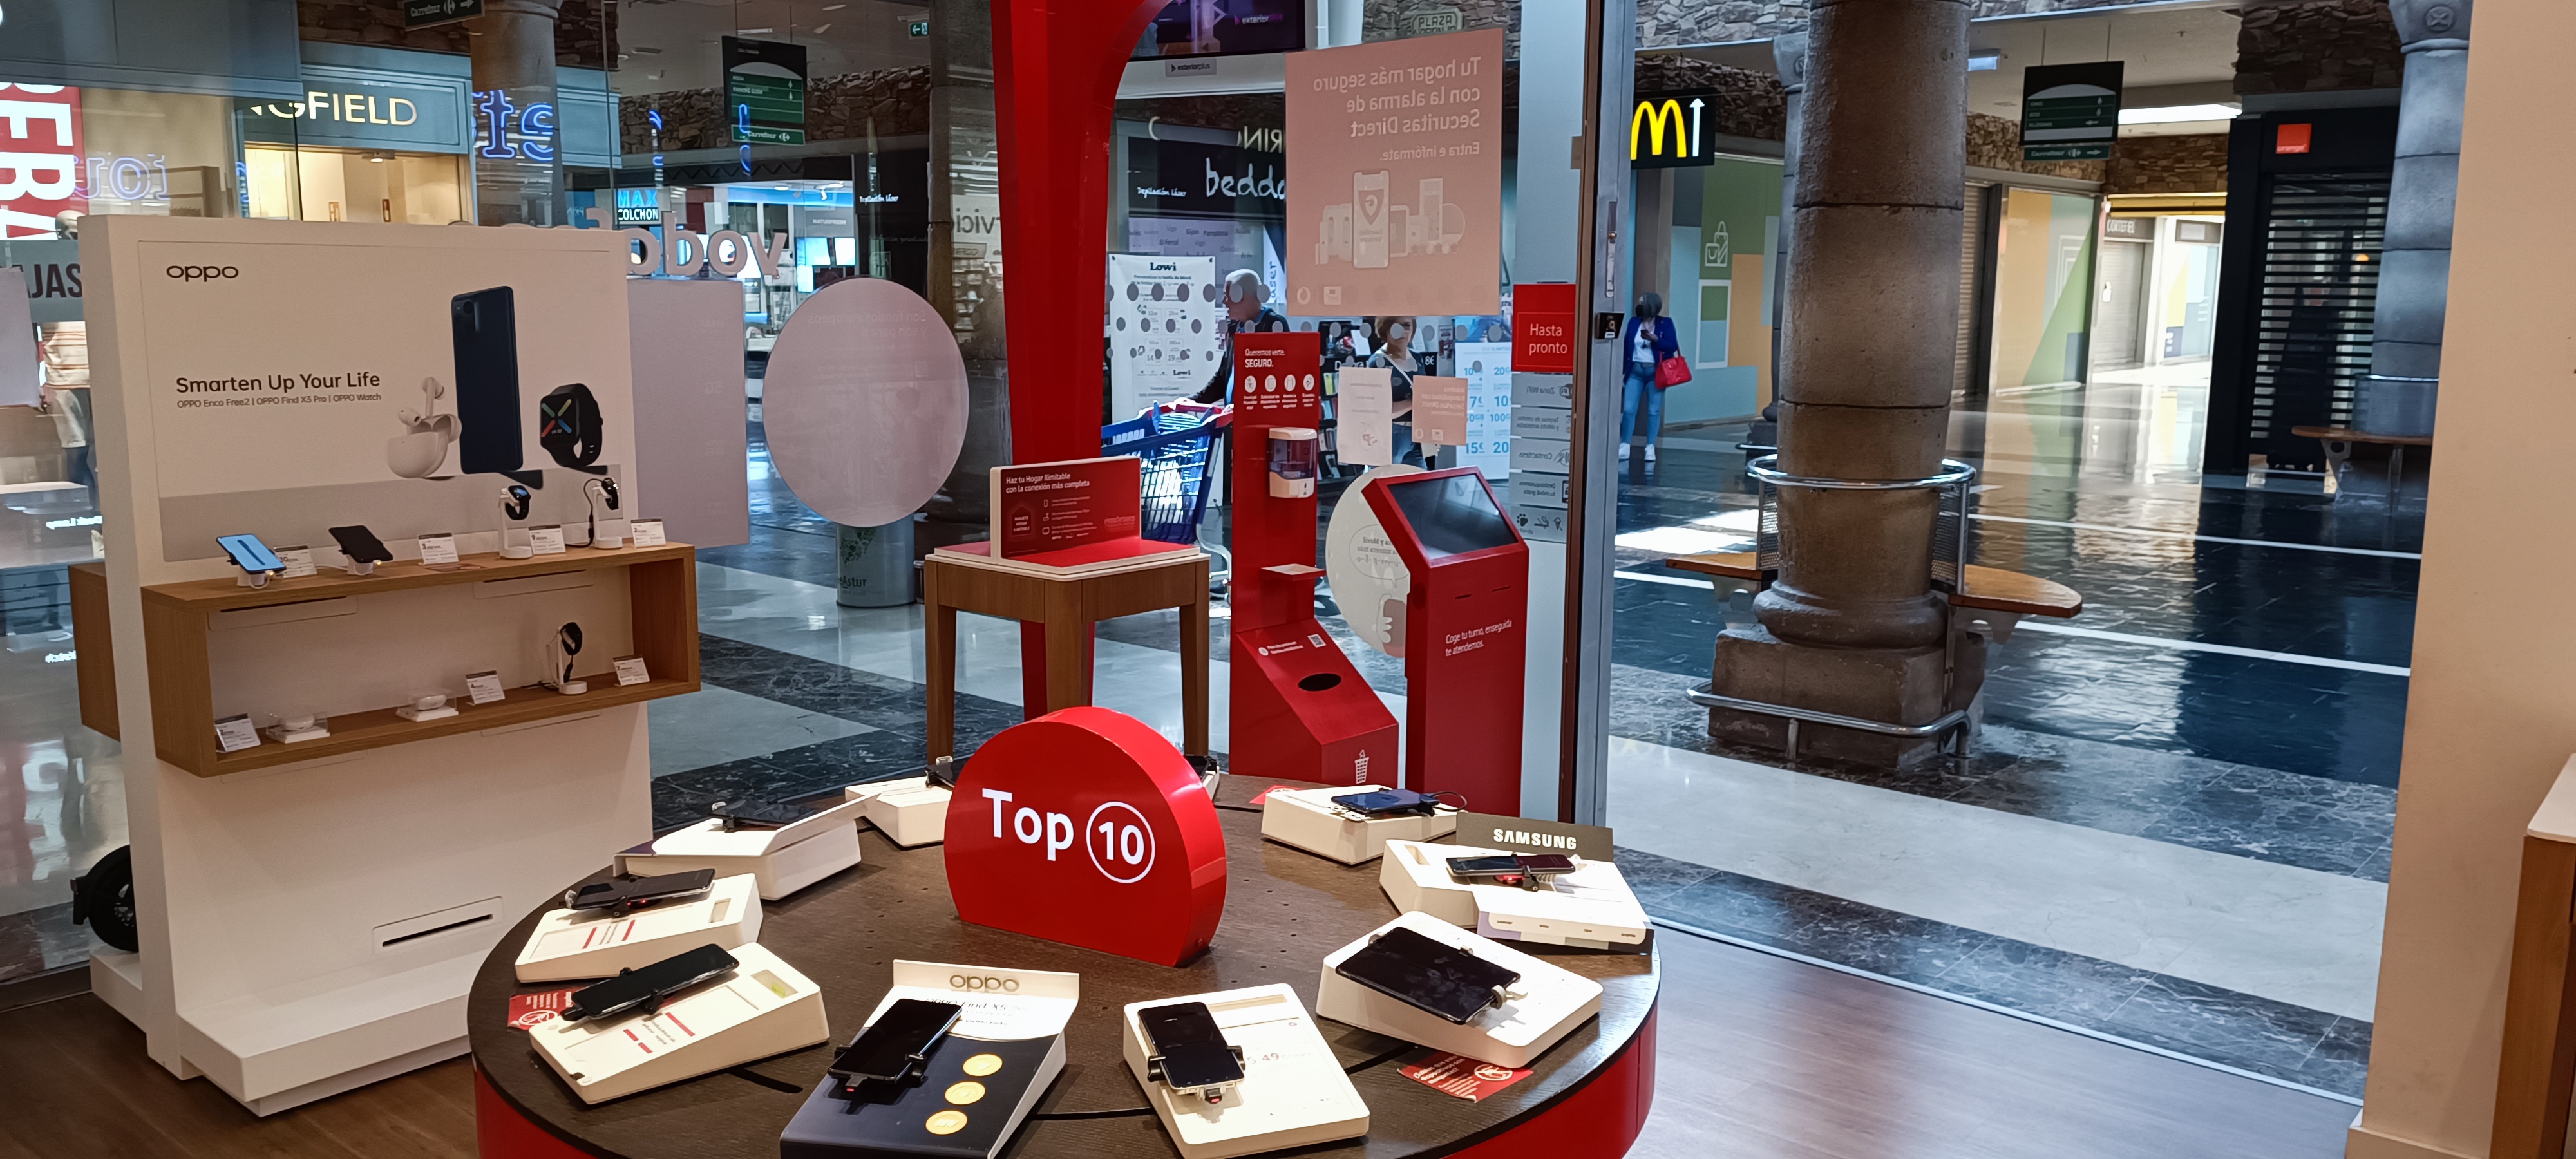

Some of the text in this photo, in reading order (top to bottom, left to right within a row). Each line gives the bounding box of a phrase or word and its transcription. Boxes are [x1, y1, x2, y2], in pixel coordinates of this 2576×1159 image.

[1419, 15, 1452, 28] PLAZA
[251, 91, 418, 126] GFIELD
[618, 189, 658, 206] MAX
[618, 208, 659, 221] COLCHON
[1150, 262, 1177, 271] Lowi
[1530, 323, 1562, 337] Hasta
[1529, 341, 1567, 356] pronto
[1245, 359, 1274, 368] SEGURO.
[176, 372, 381, 393] Smarten Up Your Life
[177, 393, 381, 408] OPPO Enco Free2 OPPO Find X3 Pro OPPO Watch
[1025, 483, 1050, 492] conexión
[1064, 480, 1090, 489] completa
[1026, 475, 1043, 484] Hogar
[1446, 634, 1461, 645] Coge
[1461, 632, 1468, 640] tu
[1485, 619, 1512, 634] enseguida
[1445, 648, 1452, 657] te
[981, 787, 1145, 866] Top 10
[1493, 828, 1577, 851] SAMSUNG
